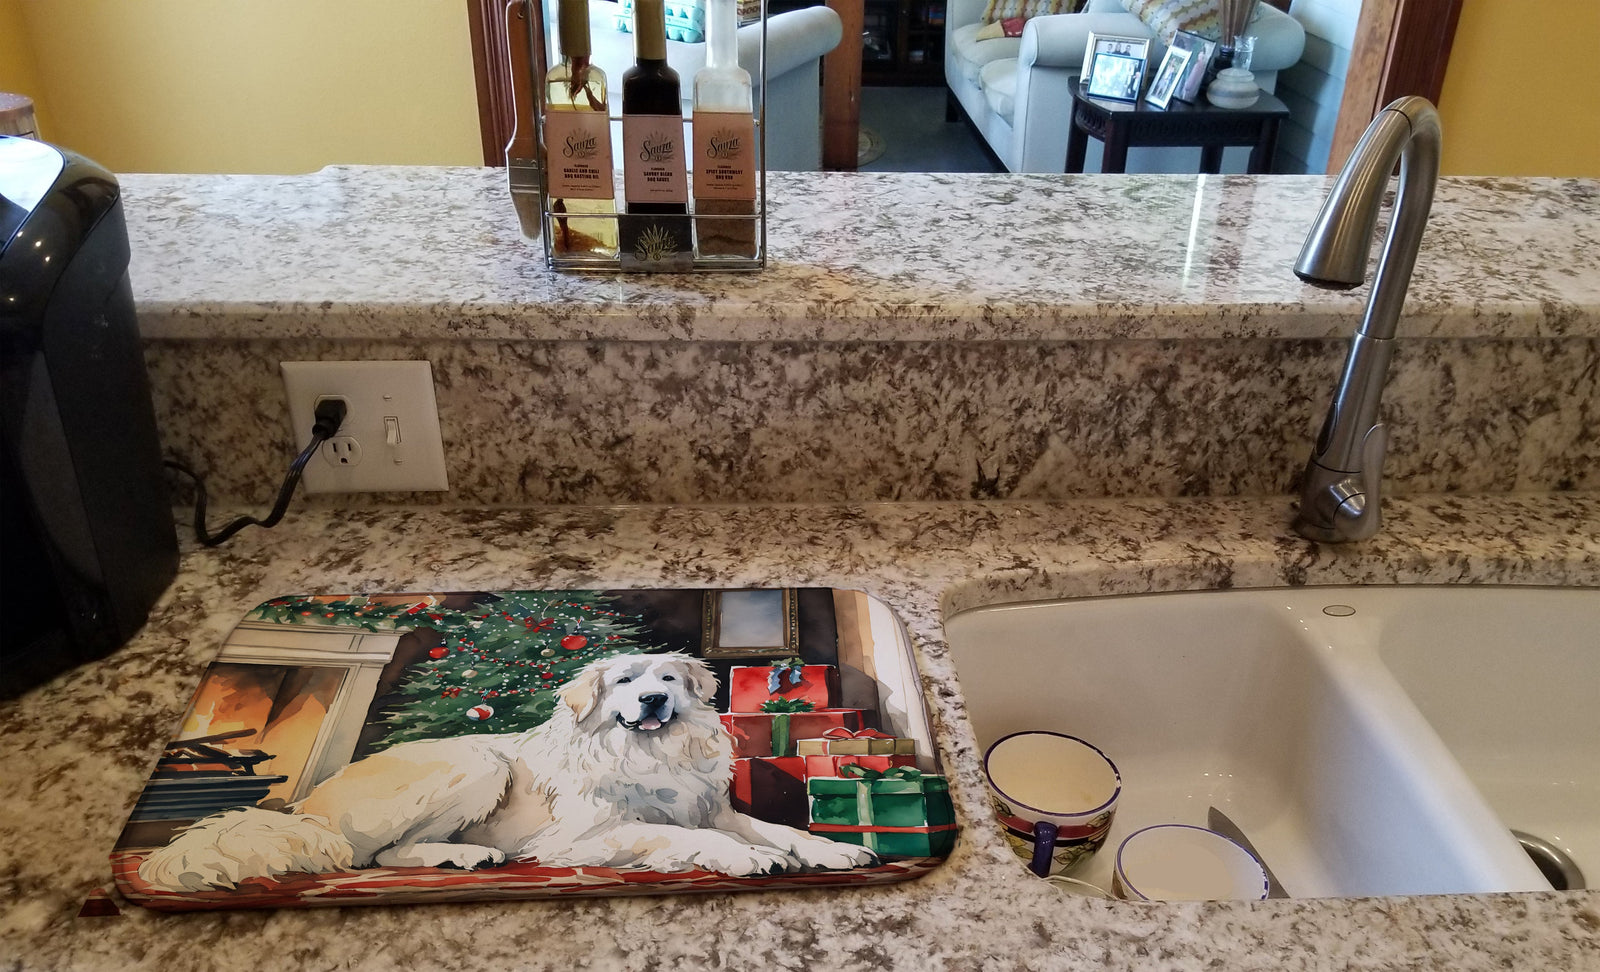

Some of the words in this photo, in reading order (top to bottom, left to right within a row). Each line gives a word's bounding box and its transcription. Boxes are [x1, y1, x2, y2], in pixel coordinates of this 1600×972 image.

[563, 136, 596, 158] Sauza
[640, 140, 674, 162] Sauza
[706, 136, 739, 159] Sauza
